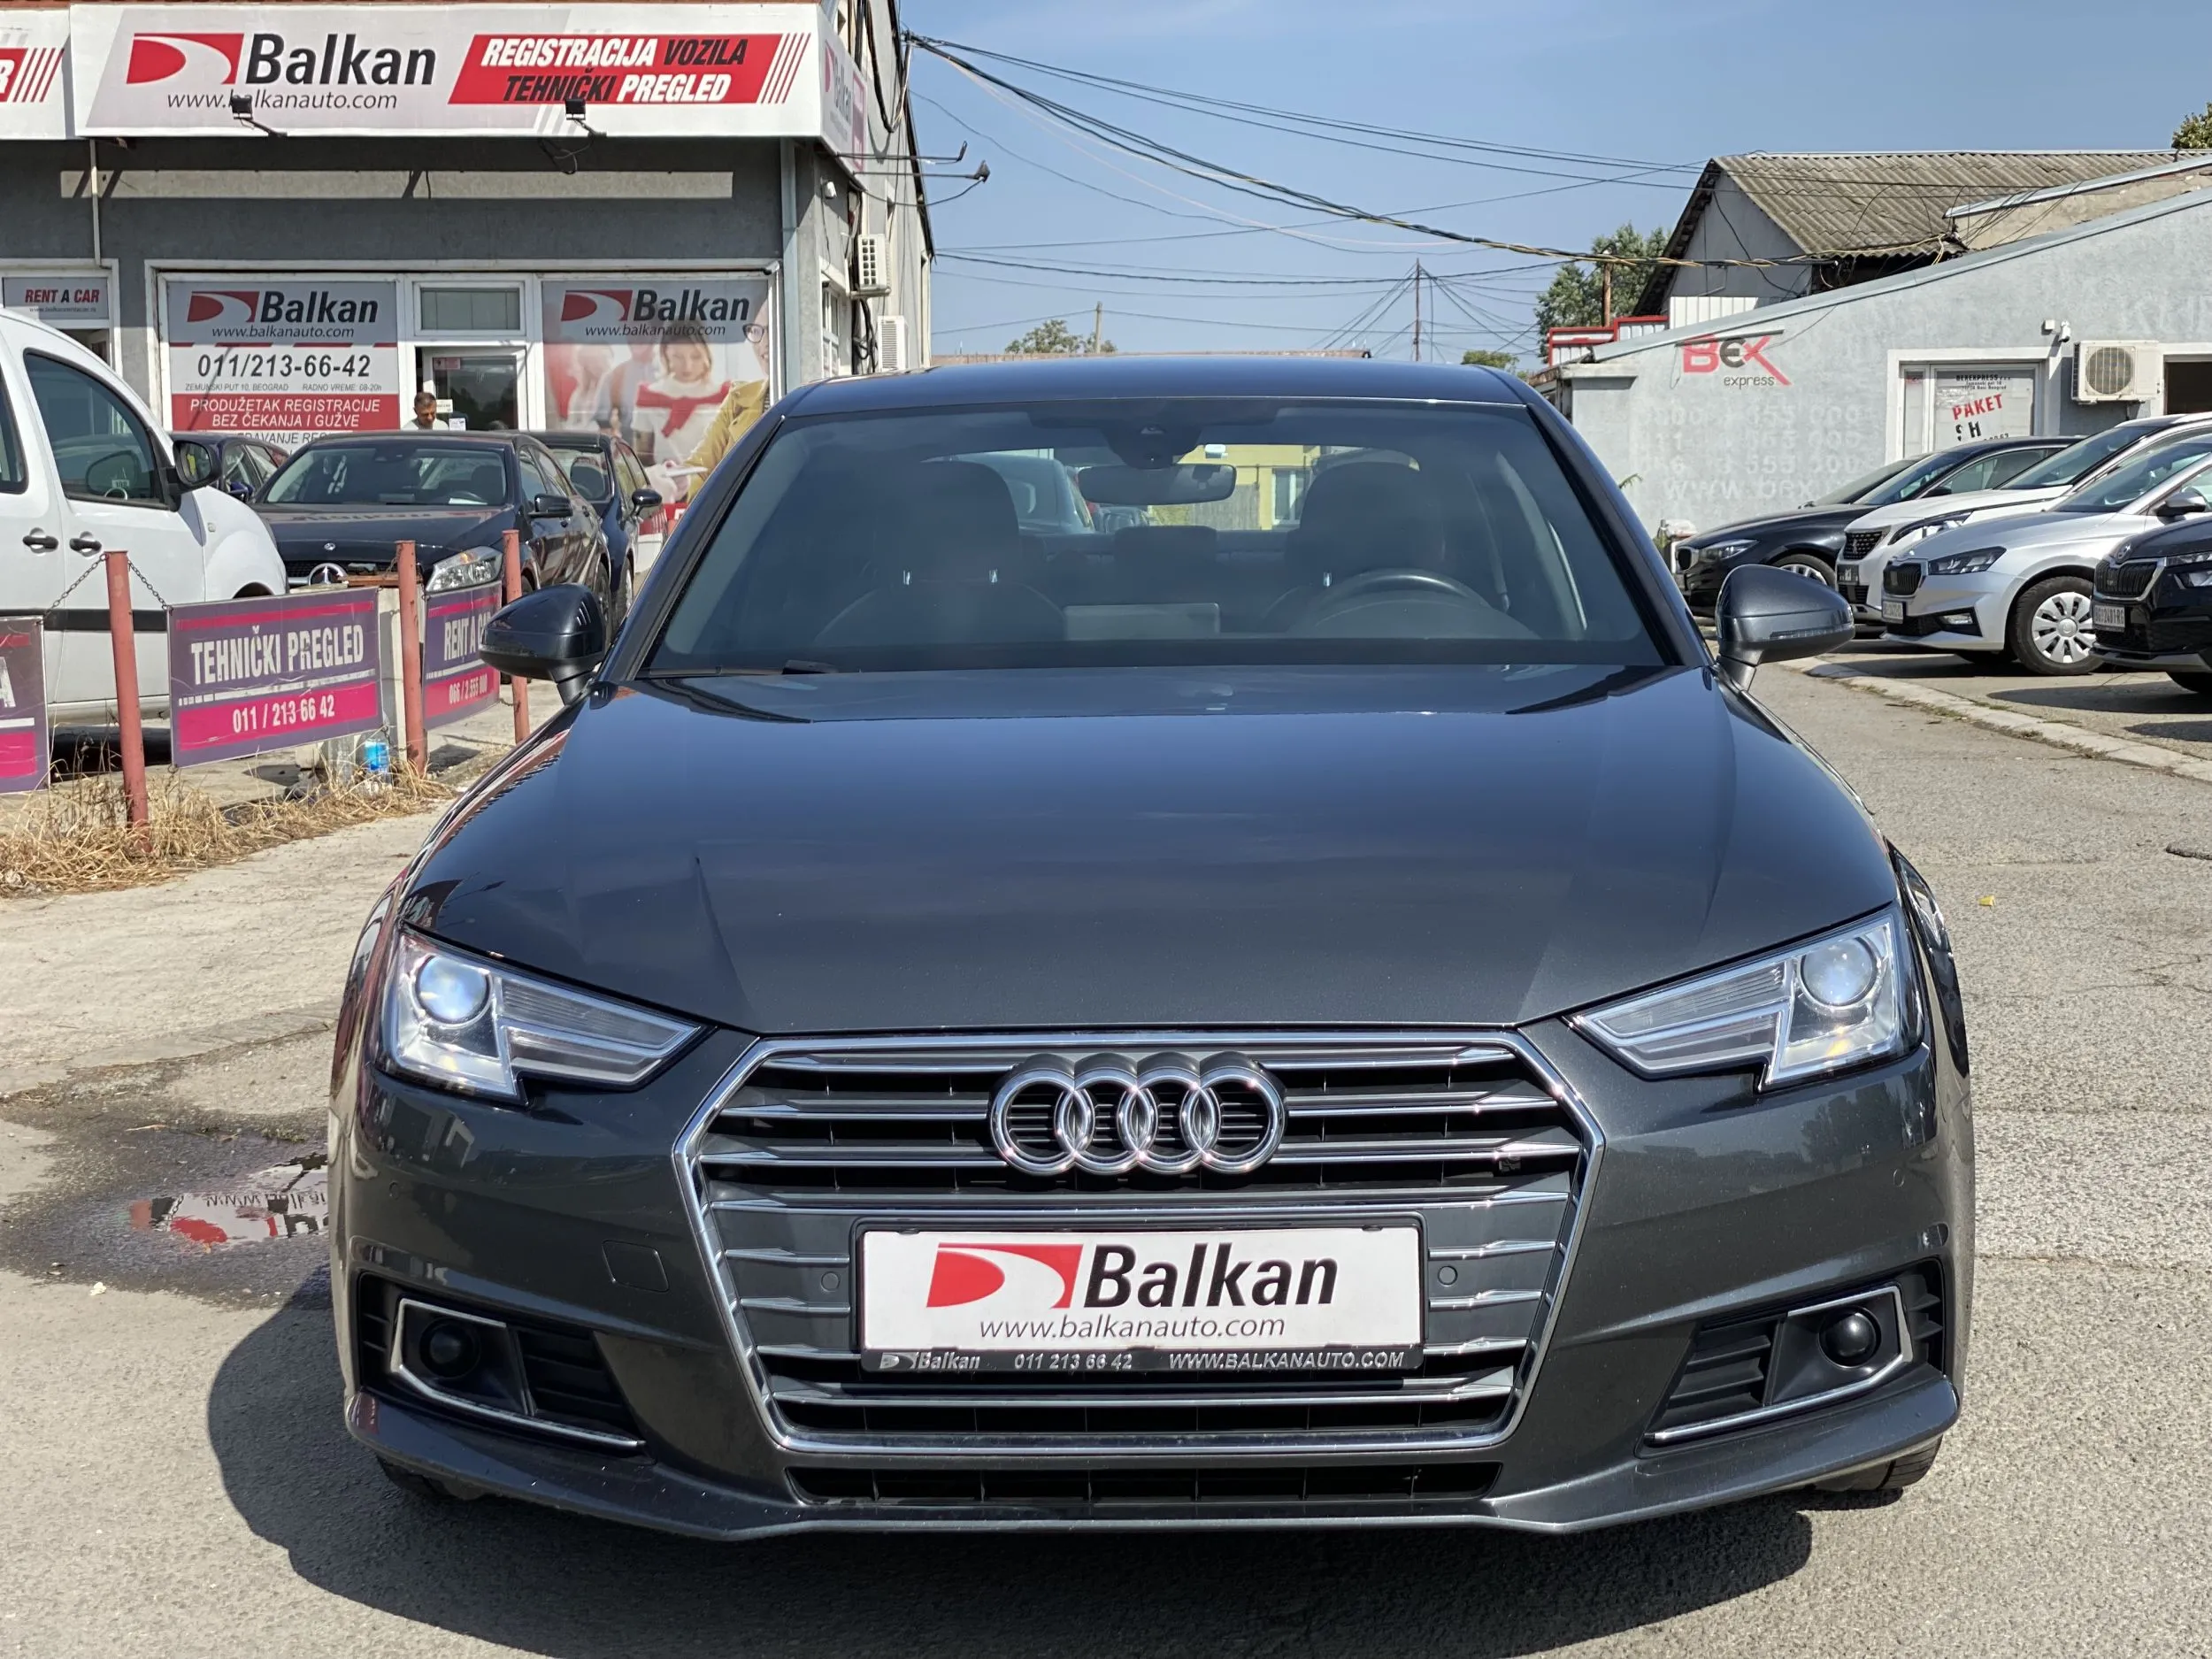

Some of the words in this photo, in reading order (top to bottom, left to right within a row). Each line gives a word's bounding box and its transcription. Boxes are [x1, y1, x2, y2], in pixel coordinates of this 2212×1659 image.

[246, 33, 436, 85] Balkan
[480, 38, 658, 66] REGISTRACIJA
[664, 39, 749, 65] VOZILA
[503, 67, 618, 102] TEHNIČKI
[616, 74, 732, 103] PREGLED
[25, 288, 59, 303] RENT
[61, 289, 70, 303] A
[73, 288, 100, 303] CAR
[260, 290, 379, 323] Balkan
[633, 288, 750, 322] Balkan
[211, 325, 355, 338] www.balkanauto.com
[585, 324, 726, 337] www.balkanauto.com
[197, 354, 371, 378] 011/213-66-42
[1724, 376, 1775, 389] express
[190, 396, 280, 412] PRODUŽETAK
[284, 398, 380, 412] REGISTRACIJE
[1952, 393, 2003, 420] PAKET
[212, 414, 238, 427] BEZ
[242, 412, 303, 427] ČEKANJA
[306, 414, 311, 426] I
[314, 412, 359, 427] GUŽVE
[444, 617, 469, 661] RENT
[470, 616, 476, 654] A
[190, 625, 281, 686] TEHNIČKI
[288, 625, 364, 672] PREGLED
[233, 706, 257, 733] 011
[273, 700, 296, 726] 213
[300, 696, 316, 722] 66
[319, 695, 334, 718] 42
[1084, 1242, 1339, 1310] Balkan
[979, 1314, 1285, 1340] www.balkanauto.com
[918, 1351, 979, 1369] Balkan
[1014, 1352, 1044, 1370] 011
[1049, 1352, 1080, 1370] 213
[1086, 1352, 1106, 1370] 66
[1110, 1352, 1133, 1370] 42
[1168, 1351, 1405, 1371] WWW.BALKANAUTO.COM
